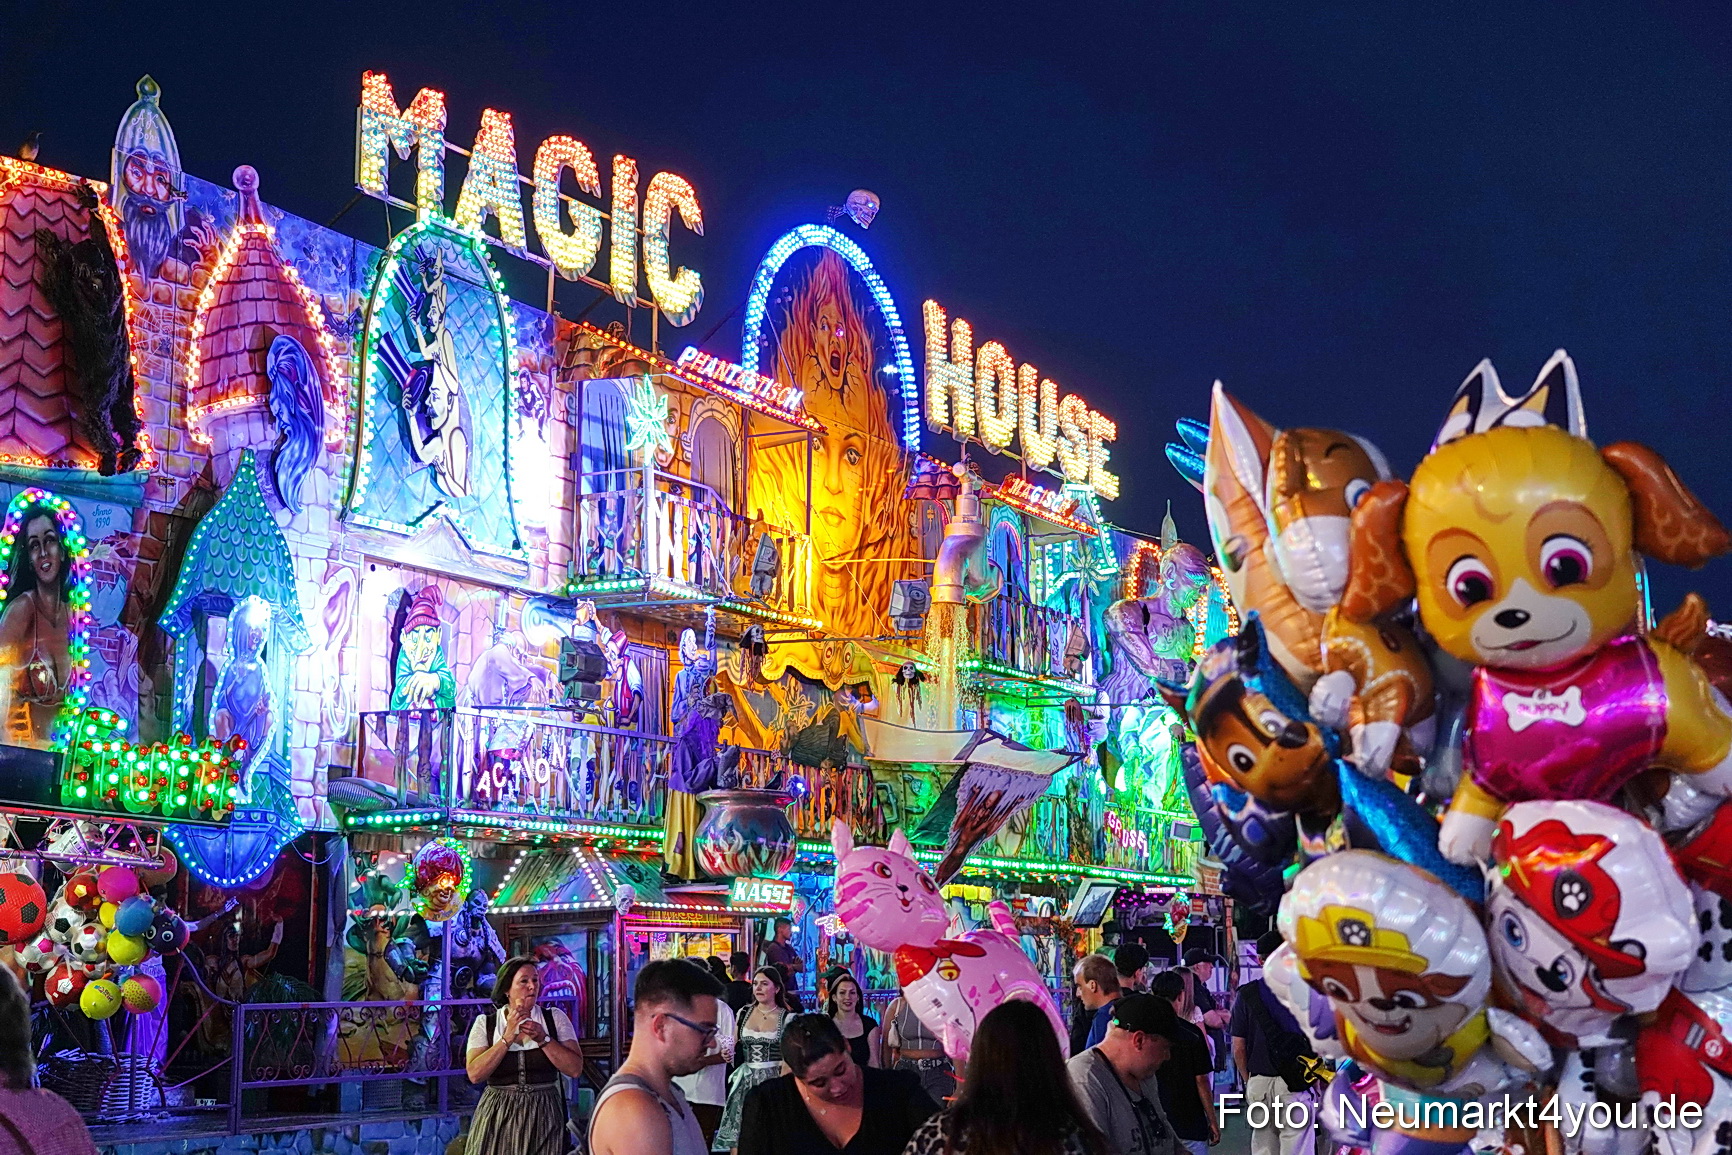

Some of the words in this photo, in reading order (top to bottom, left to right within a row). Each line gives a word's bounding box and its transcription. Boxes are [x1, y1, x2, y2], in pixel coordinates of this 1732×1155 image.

[361, 70, 704, 328] MAGIC
[677, 345, 804, 411] PHANTASTISCH
[923, 299, 1120, 501] HOUSE
[733, 881, 793, 905] KASSE
